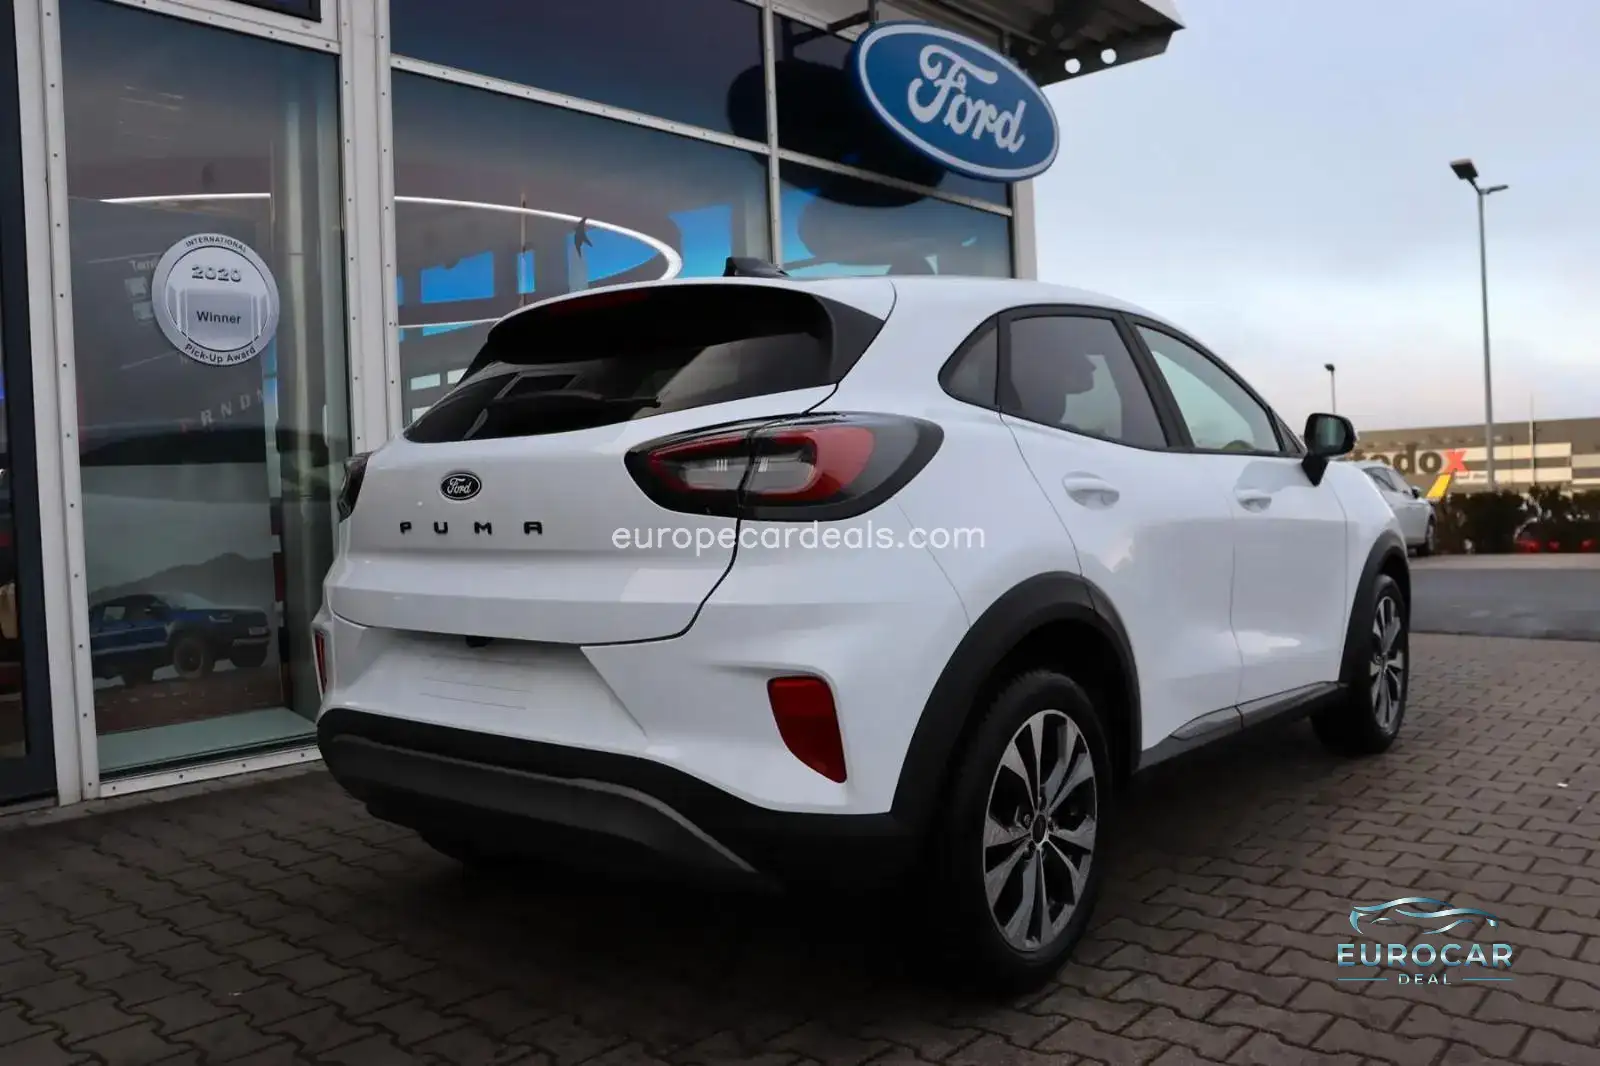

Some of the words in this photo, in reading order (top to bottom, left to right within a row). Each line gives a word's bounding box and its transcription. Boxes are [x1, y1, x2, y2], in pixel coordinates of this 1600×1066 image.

[907, 44, 1026, 153] Ford
[185, 236, 247, 253] INTERNATIONAL
[191, 265, 242, 283] 2020
[196, 310, 242, 324] Winner
[184, 343, 223, 363] Pick-Up
[226, 346, 256, 362] Award
[446, 477, 472, 494] Ford
[400, 521, 543, 535] PUMA
